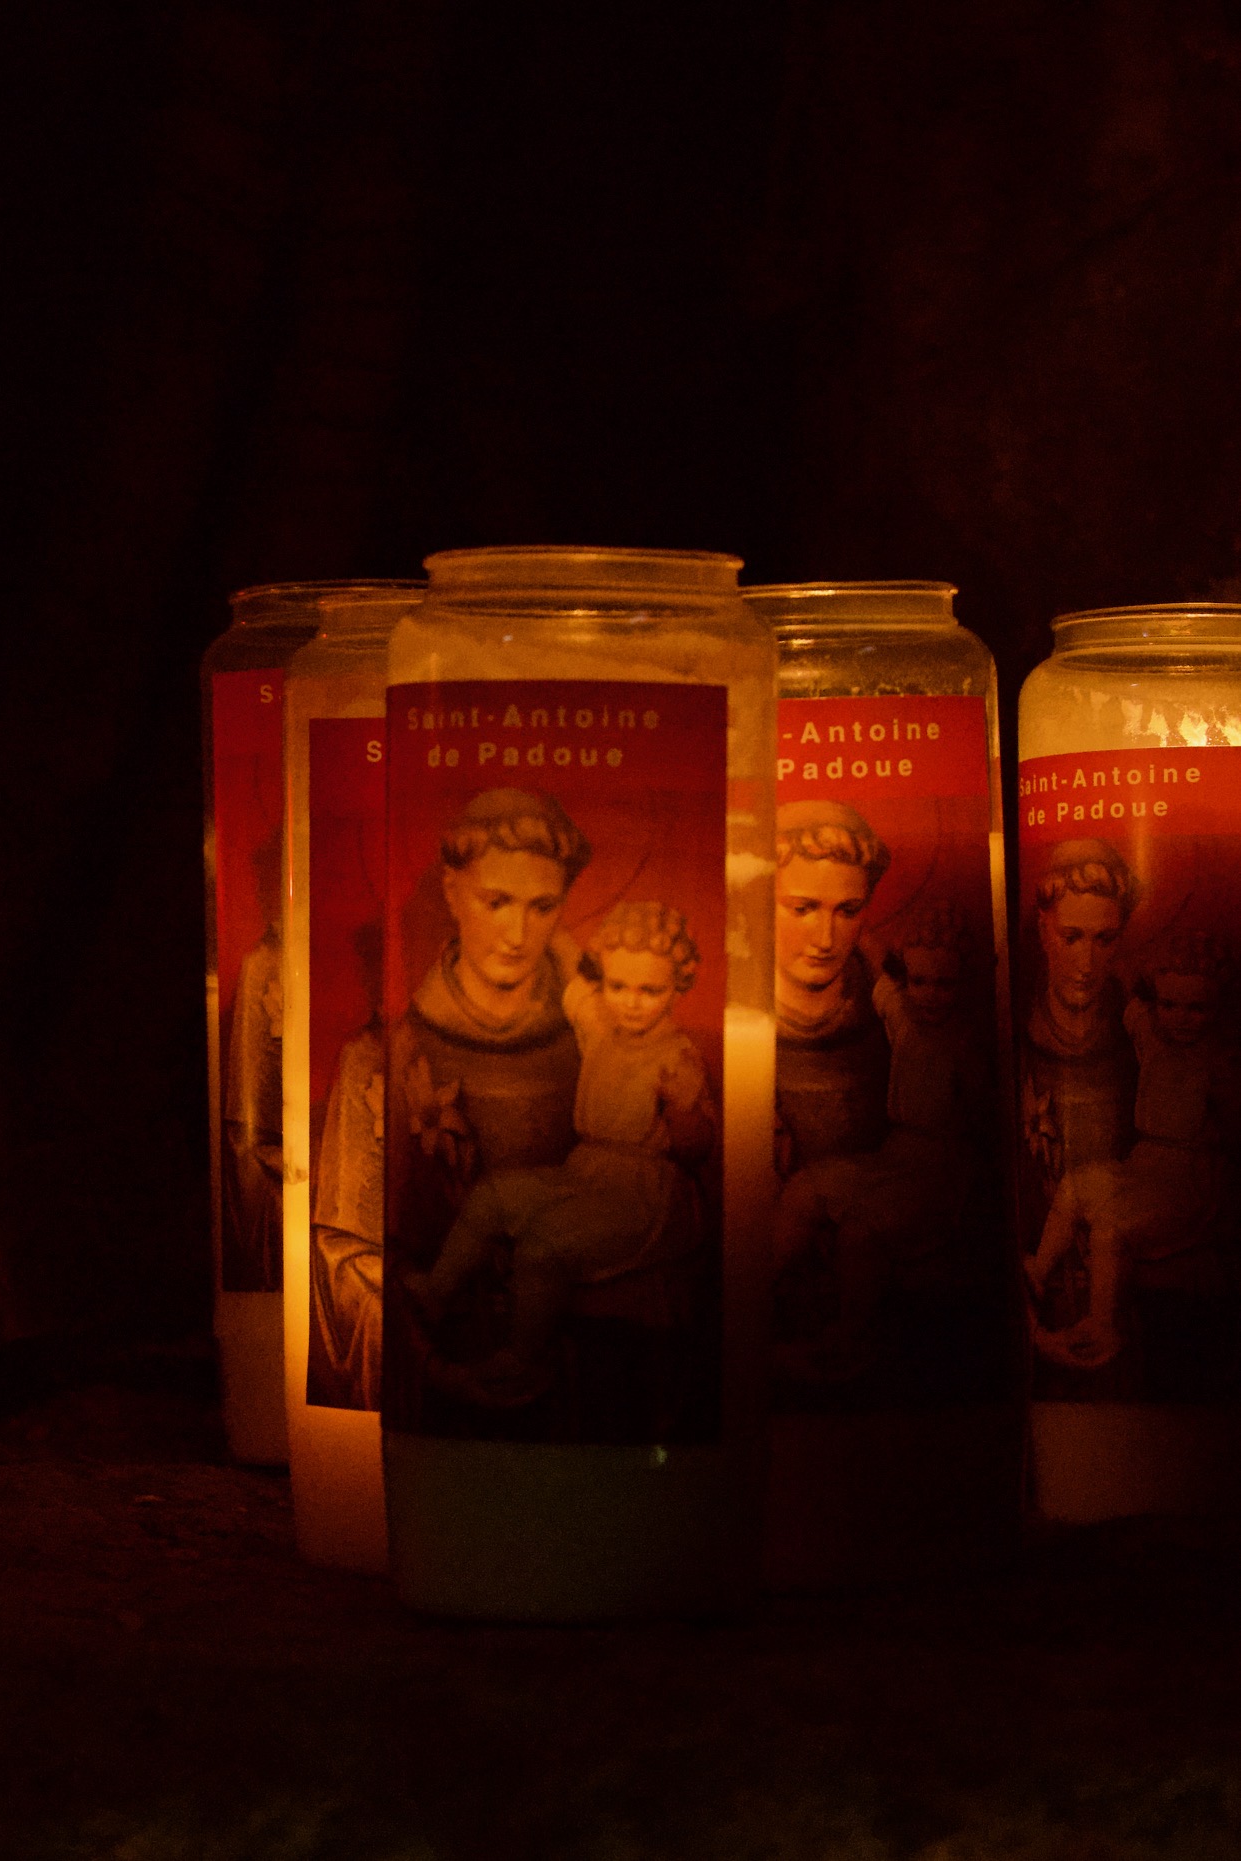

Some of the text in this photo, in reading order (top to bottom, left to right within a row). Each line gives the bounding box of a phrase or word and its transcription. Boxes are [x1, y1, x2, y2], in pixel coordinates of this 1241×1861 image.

[407, 703, 660, 731] Saint-Antoine
[782, 718, 941, 744] -Antoine
[426, 741, 624, 768] de Padoue
[777, 757, 913, 781] Padoue
[1019, 764, 1201, 797] Saint-Antoine
[1027, 800, 1169, 827] de Padoue
